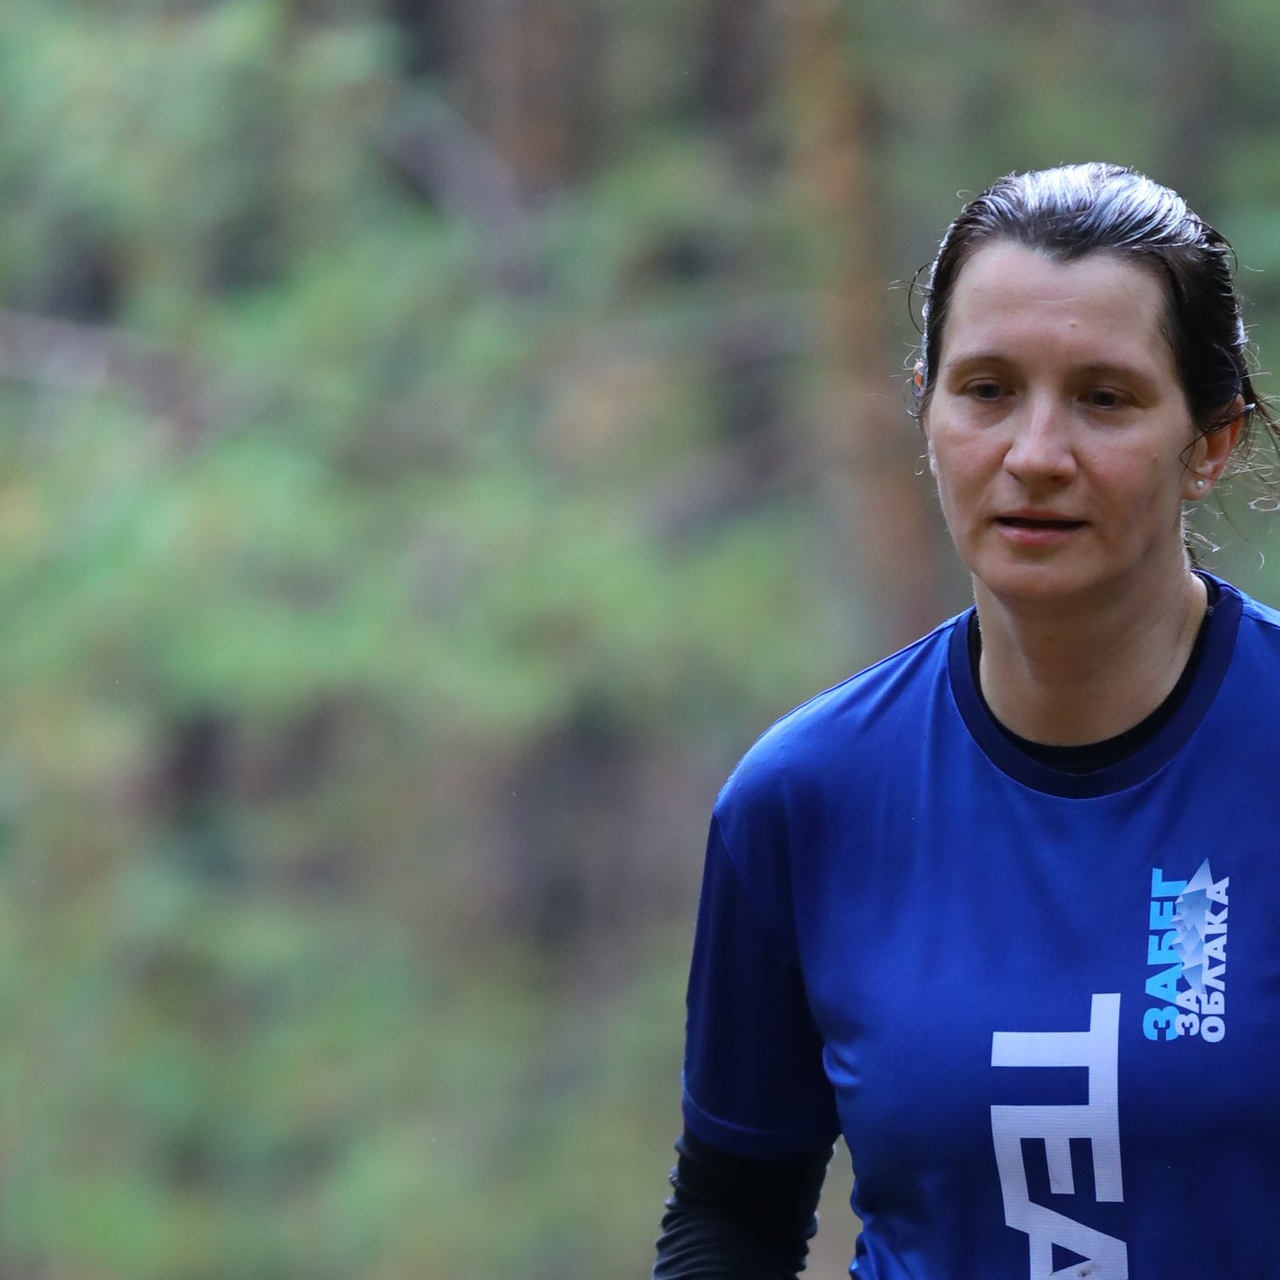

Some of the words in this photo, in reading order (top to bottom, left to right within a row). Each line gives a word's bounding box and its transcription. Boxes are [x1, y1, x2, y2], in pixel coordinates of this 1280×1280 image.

[1143, 867, 1187, 1041] ЗАБЕГ
[1175, 987, 1200, 1036] ЗА
[1200, 875, 1230, 1043] ОБЛАКА
